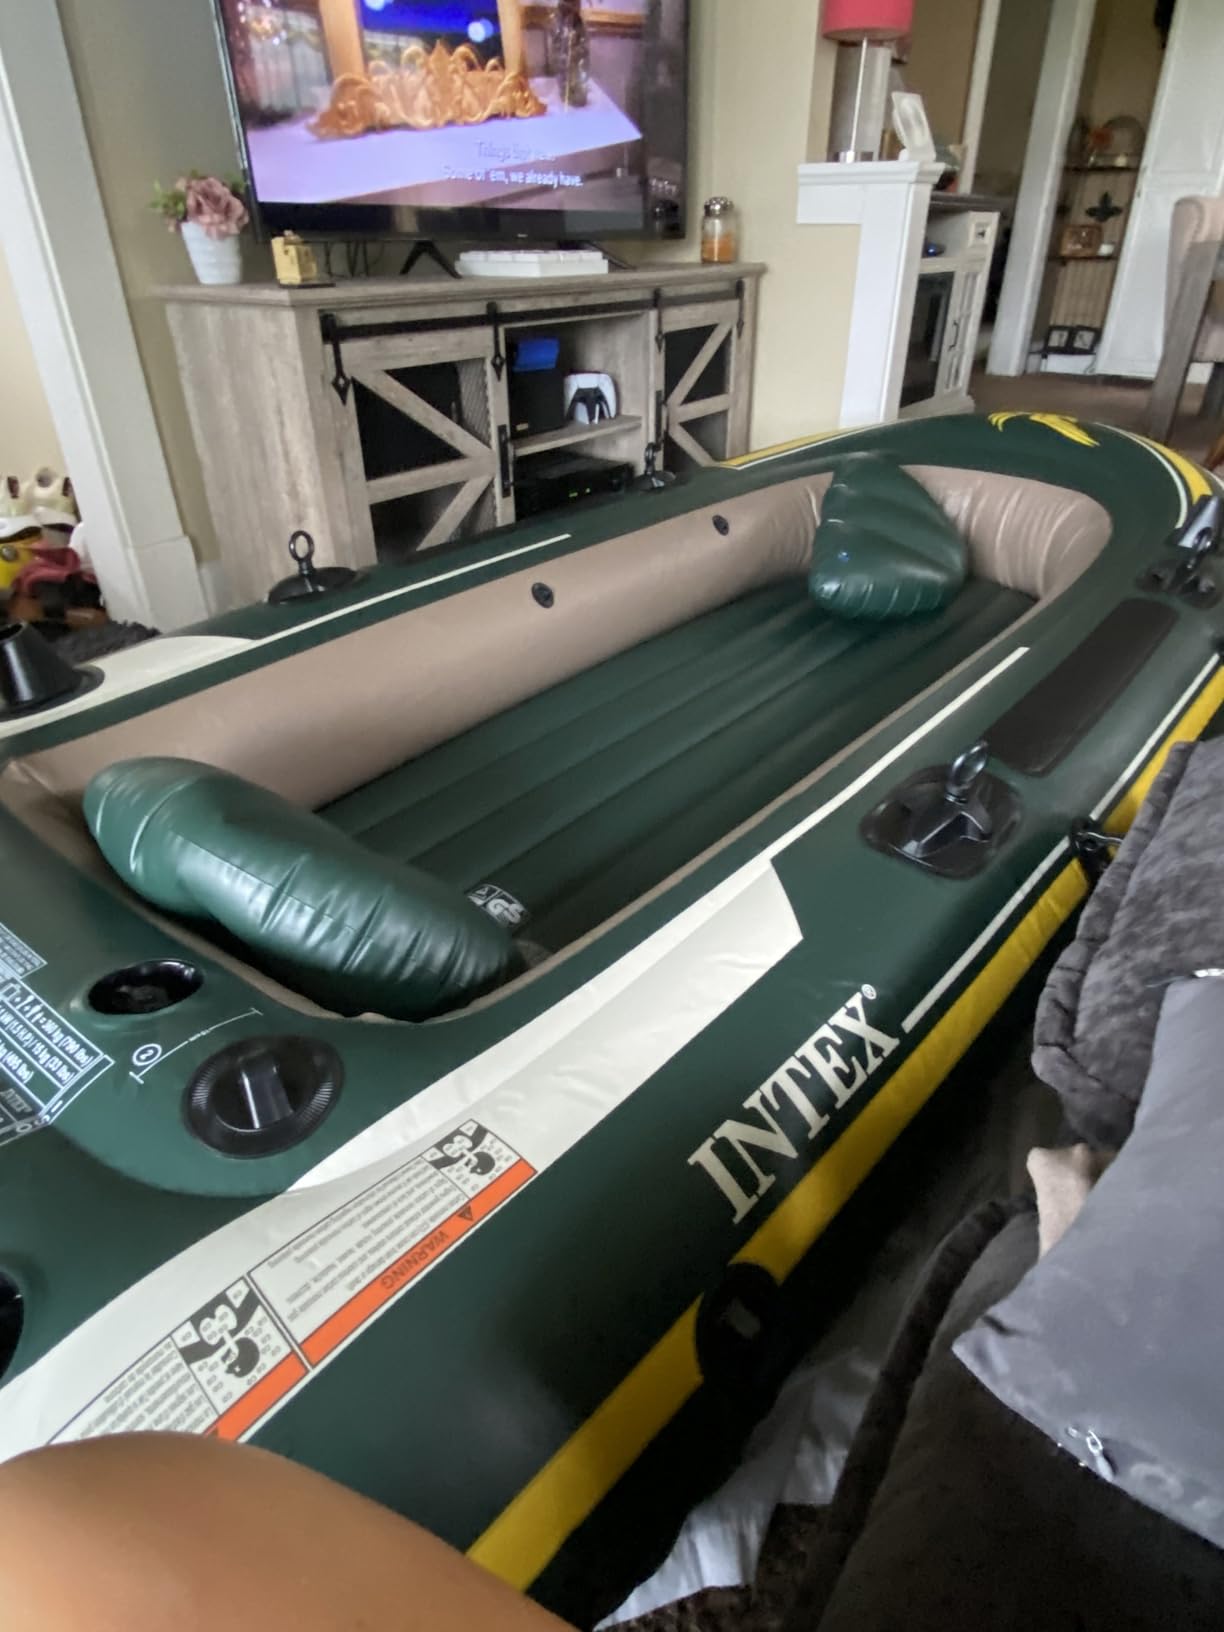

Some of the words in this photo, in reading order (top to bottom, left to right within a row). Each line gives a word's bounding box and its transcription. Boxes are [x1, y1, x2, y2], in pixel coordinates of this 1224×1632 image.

[525, 169, 558, 189] already
[687, 987, 900, 1225] INTEX
[381, 1230, 449, 1290] WARNING
